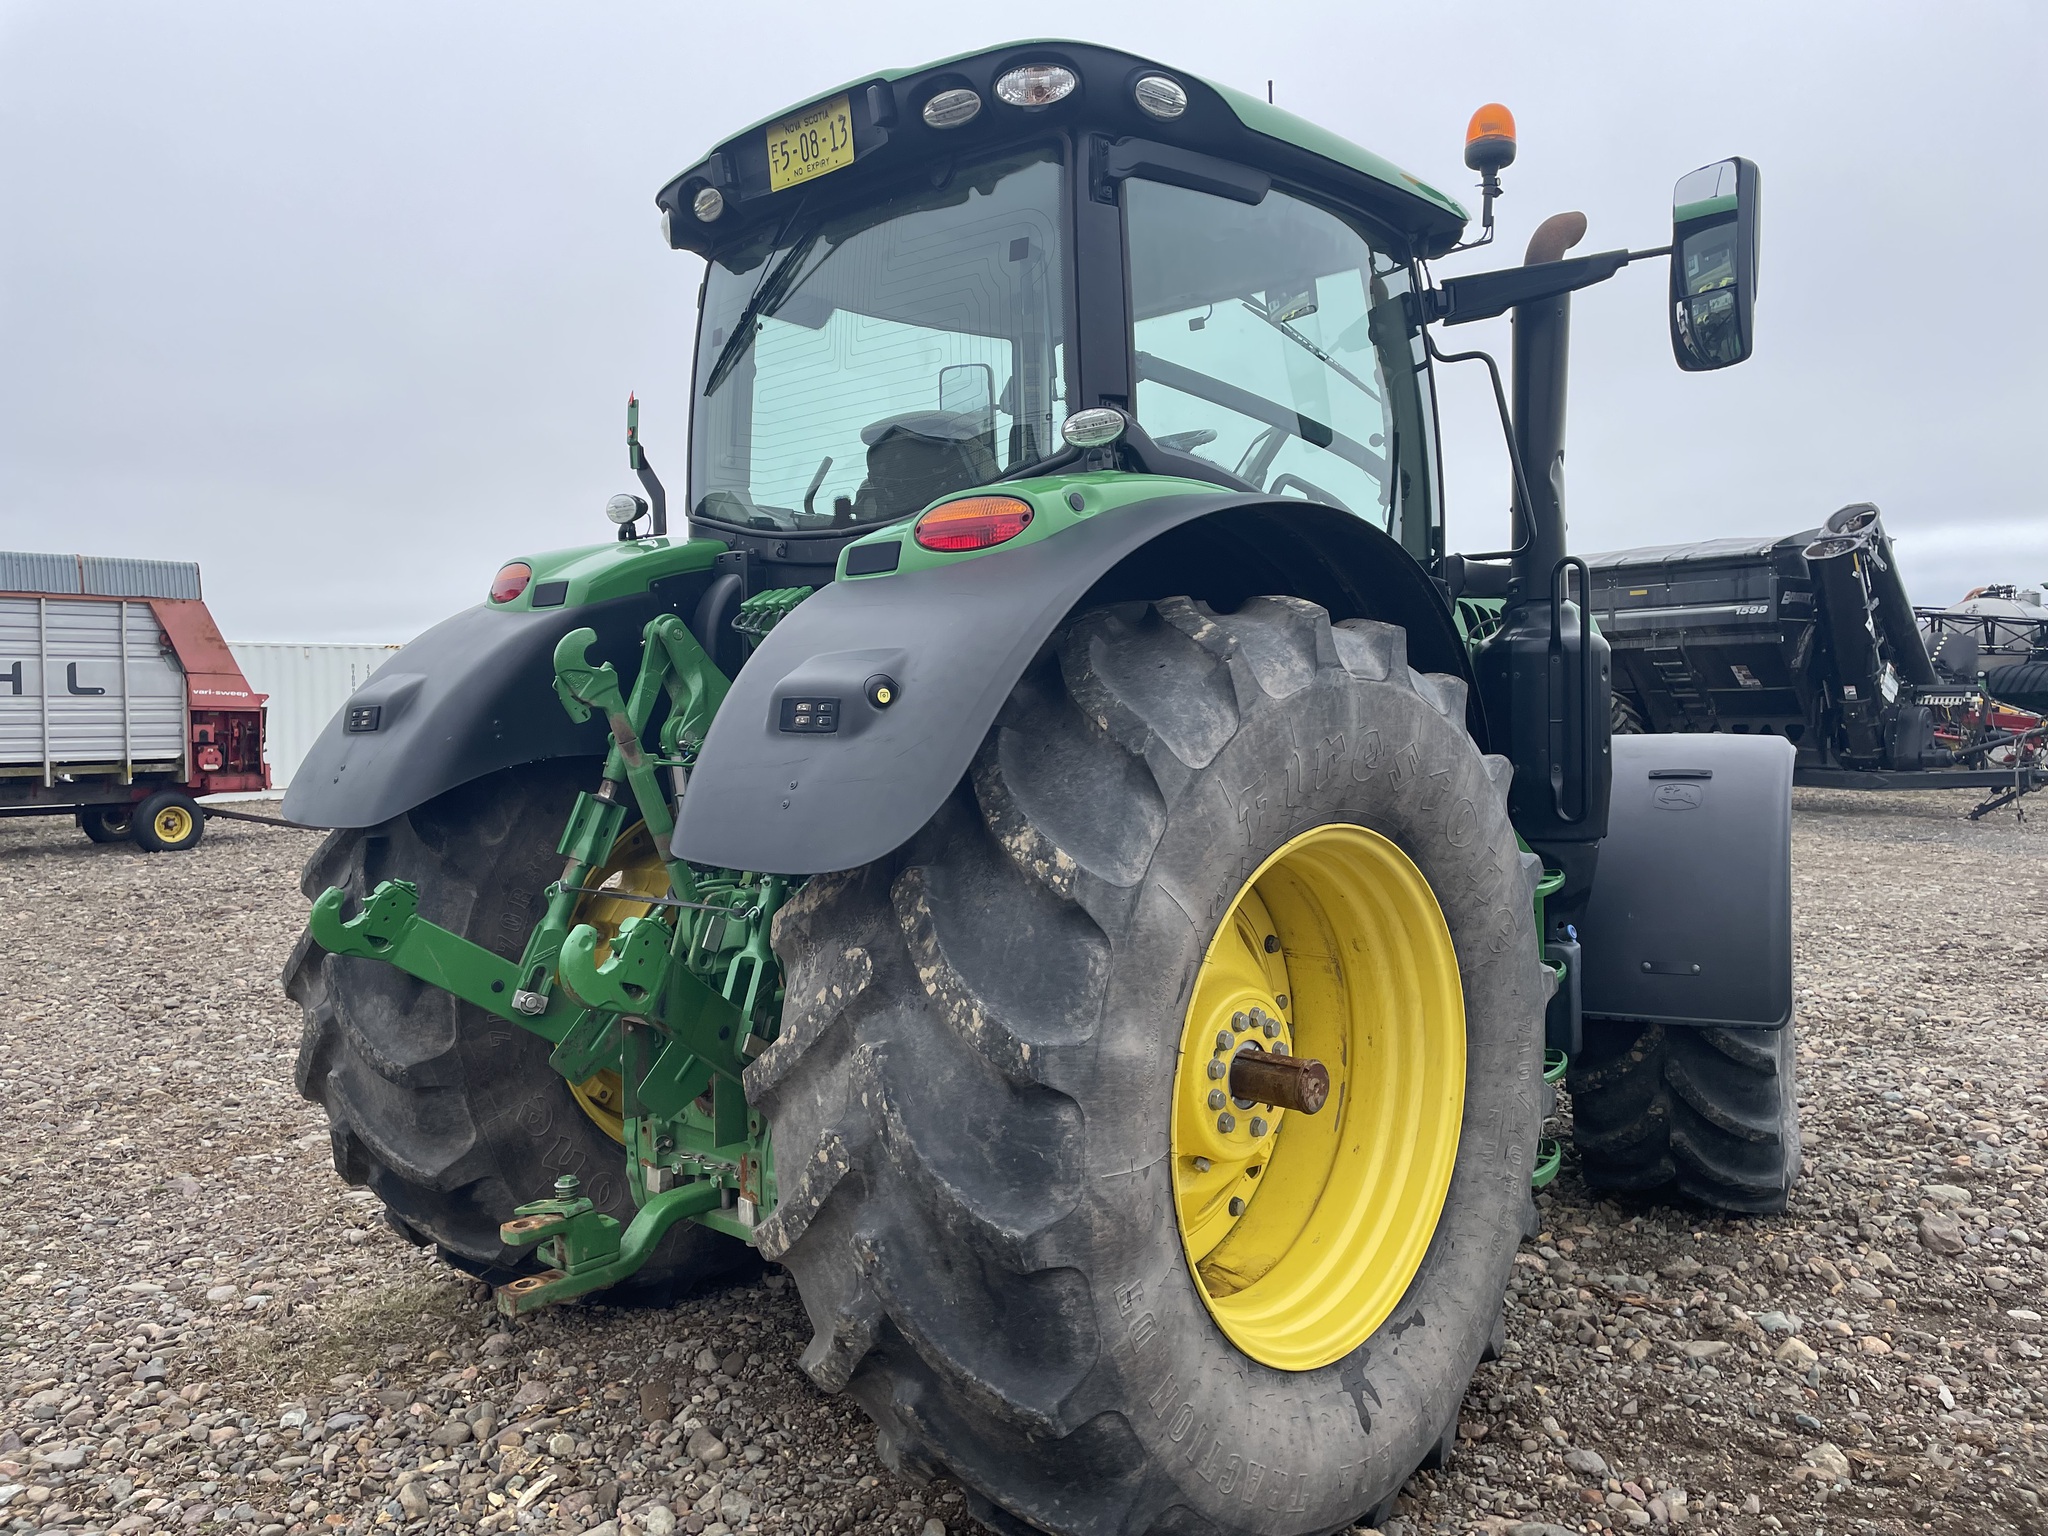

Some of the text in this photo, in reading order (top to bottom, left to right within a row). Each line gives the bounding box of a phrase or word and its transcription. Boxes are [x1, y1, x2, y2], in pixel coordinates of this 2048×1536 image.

[784, 110, 830, 136] NOVA SCOTIA
[793, 157, 831, 177] NO EXPIRY
[1735, 604, 1769, 615] 1598
[193, 688, 249, 698] vari-sweep
